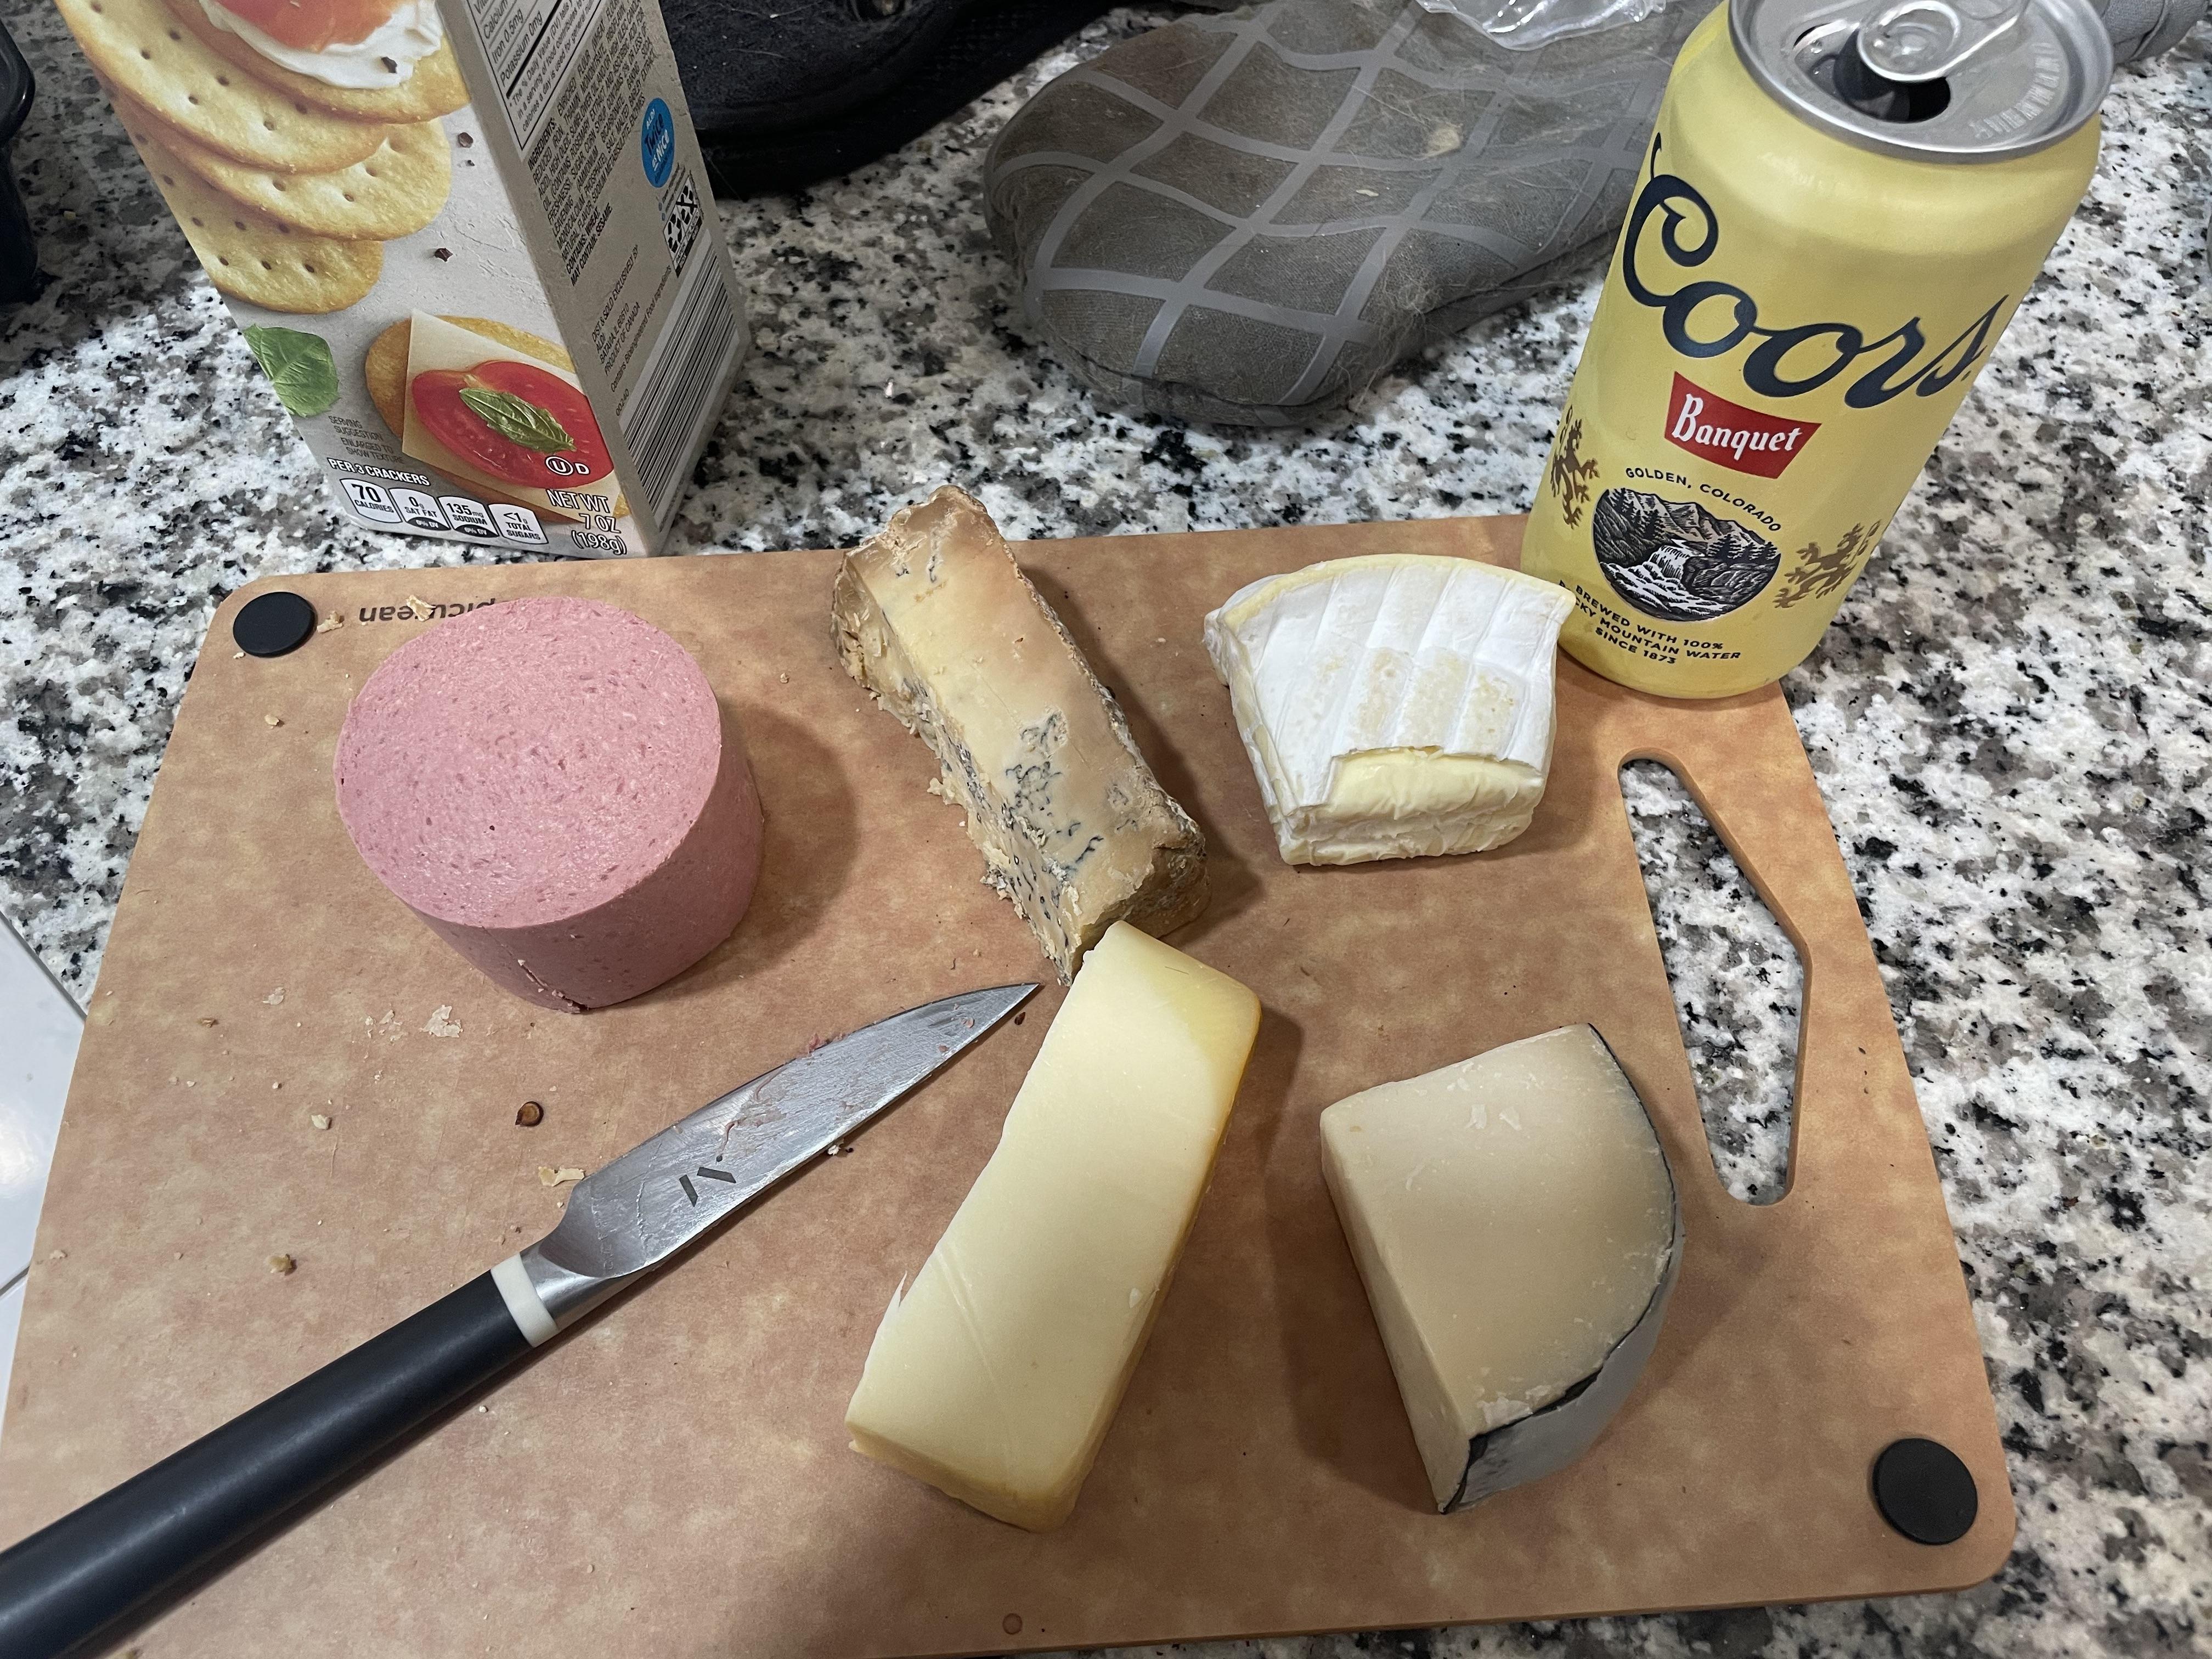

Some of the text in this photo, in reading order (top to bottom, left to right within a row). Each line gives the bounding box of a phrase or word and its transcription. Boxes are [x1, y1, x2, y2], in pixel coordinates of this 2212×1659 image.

[482, 0, 508, 42] Calcium
[491, 4, 524, 65] Iron 0.5mg
[499, 7, 543, 88] Potassium 0mg
[512, 85, 523, 108] The
[526, 55, 539, 83] Daily
[537, 33, 551, 61] Value
[549, 14, 562, 41] (DV)
[521, 97, 540, 133] calories
[570, 263, 581, 287] MAY
[1622, 132, 2009, 409] Coors
[602, 295, 614, 321] SOLD
[603, 337, 622, 377] PRODUCT
[624, 300, 640, 333] CANADA
[614, 387, 630, 417] 00240
[329, 415, 363, 428] SERVING
[334, 426, 384, 441] SUGGESTION
[1671, 392, 1804, 461] Banquet
[341, 437, 394, 454] ENLARGED TO
[346, 447, 405, 464] SHOW TEXTURE
[327, 458, 431, 486] PER 3 CRACKERS
[351, 483, 382, 503] 70
[546, 489, 610, 514] NET WT
[1626, 467, 1781, 531] GOLDEN, COLORADO
[354, 500, 394, 513] CALORIES
[405, 506, 438, 518] SAT FAT
[453, 515, 488, 526] SODIUM
[505, 522, 533, 532] TOTAL
[579, 513, 621, 534] 7 OZ
[506, 530, 541, 540] SUGARS
[572, 530, 627, 555] (198g)
[1576, 584, 1630, 627] BREWED
[1637, 624, 1678, 644] WITH
[1684, 639, 1724, 650] 100%
[1595, 627, 1677, 664] SINCE 1873
[1599, 617, 1680, 654] MOUNTAIN
[1686, 650, 1741, 659] WATER
